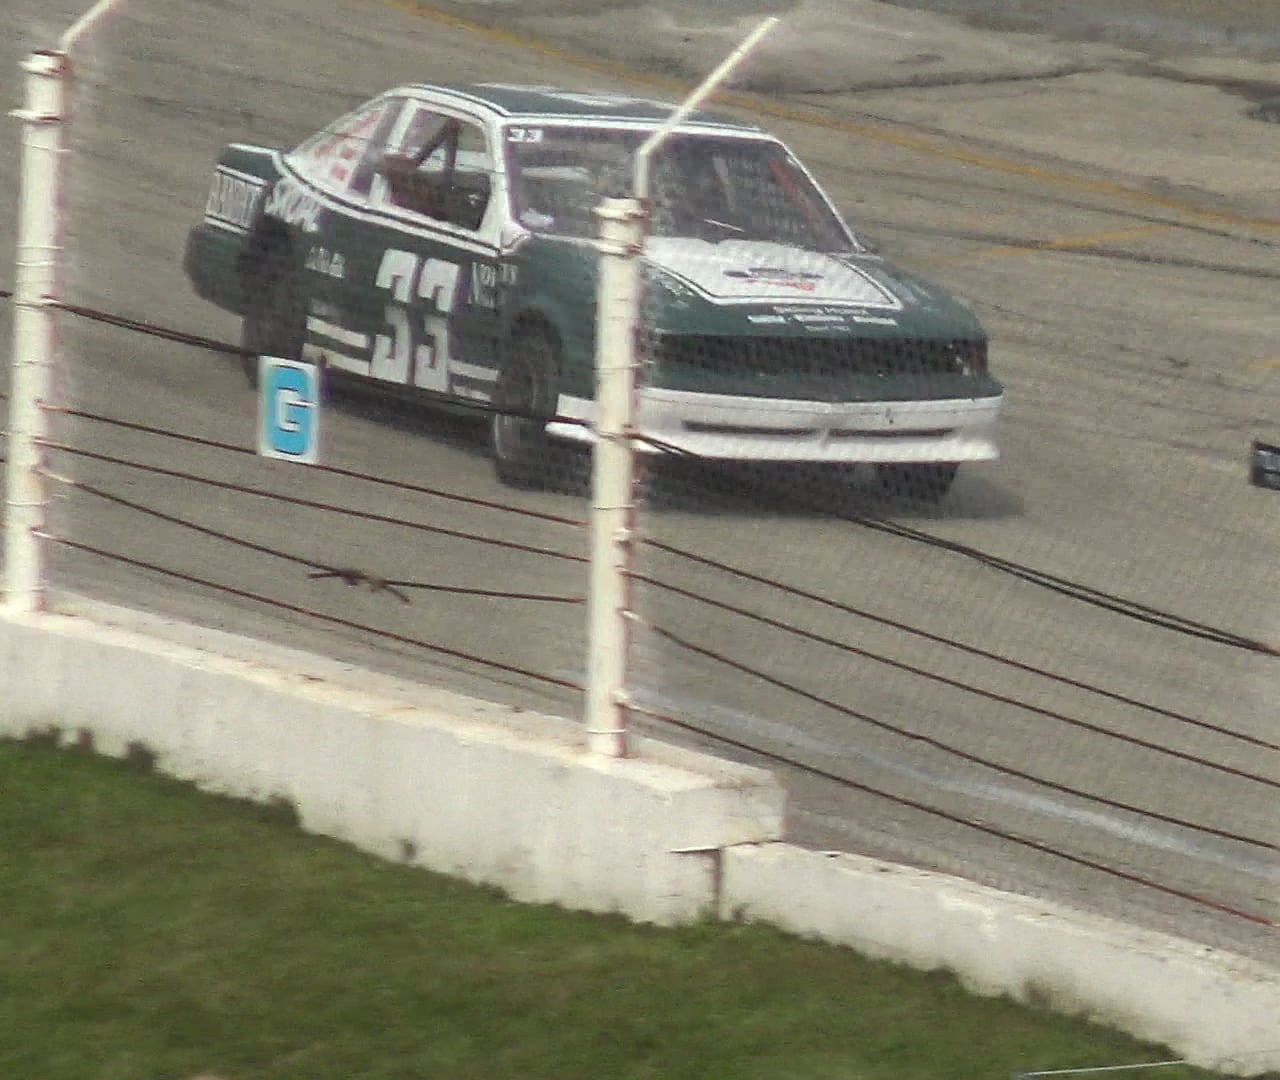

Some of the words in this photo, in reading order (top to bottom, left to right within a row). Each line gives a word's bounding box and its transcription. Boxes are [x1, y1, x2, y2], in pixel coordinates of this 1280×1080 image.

[507, 127, 544, 143] 33
[371, 248, 460, 393] 33
[264, 364, 318, 457] G
